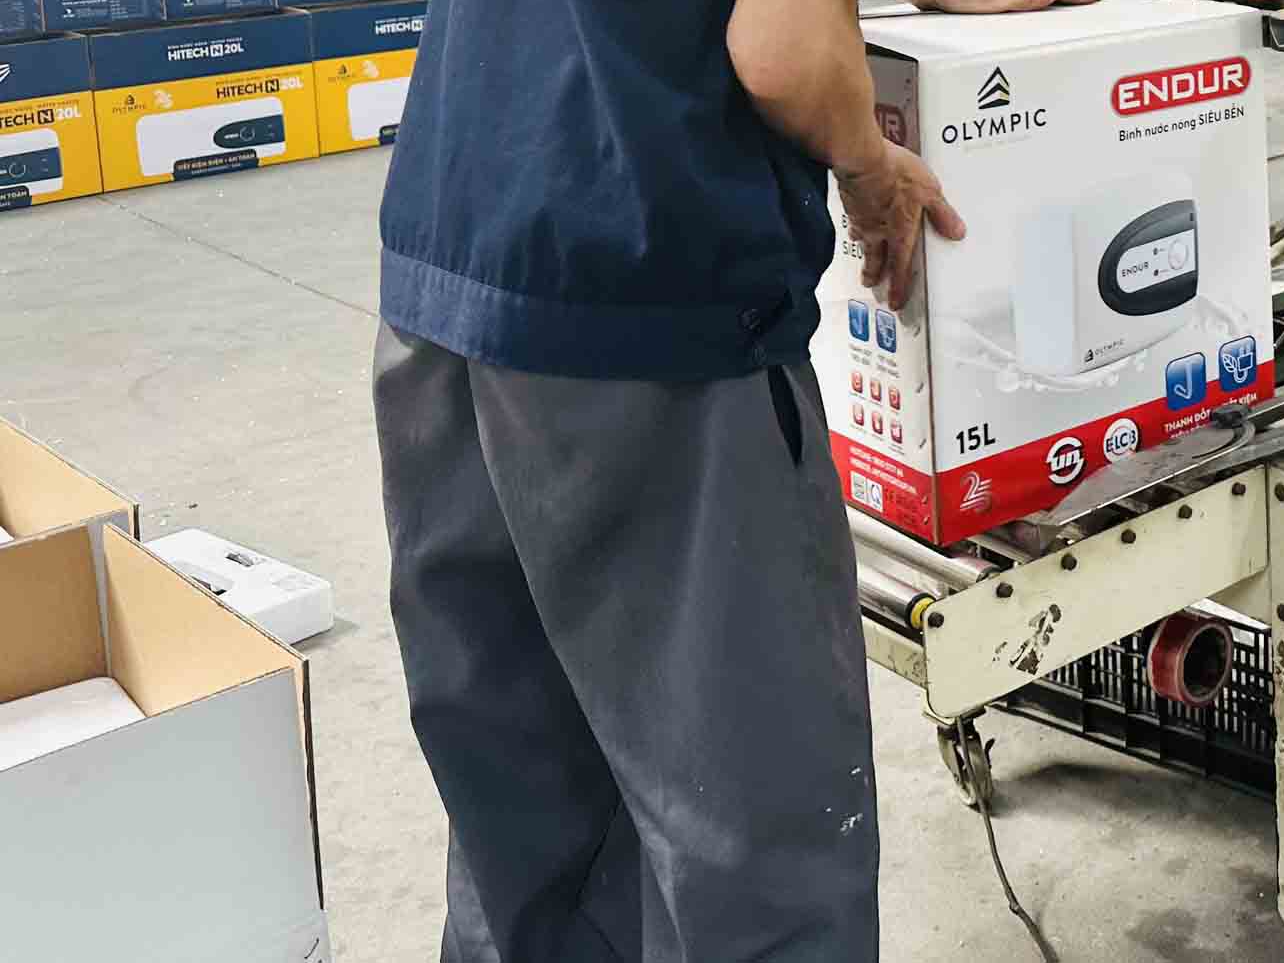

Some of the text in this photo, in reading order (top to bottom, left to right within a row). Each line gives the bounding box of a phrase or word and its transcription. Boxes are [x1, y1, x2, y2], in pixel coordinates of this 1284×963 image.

[168, 46, 209, 61] HITECH
[225, 42, 245, 54] 20L
[216, 83, 263, 99] HITECH
[1119, 63, 1245, 110] ENDUR
[942, 109, 1047, 144] OLYMPIC
[1121, 261, 1150, 278] ENDUR
[1164, 416, 1193, 433] THANH
[956, 423, 997, 455] 15L
